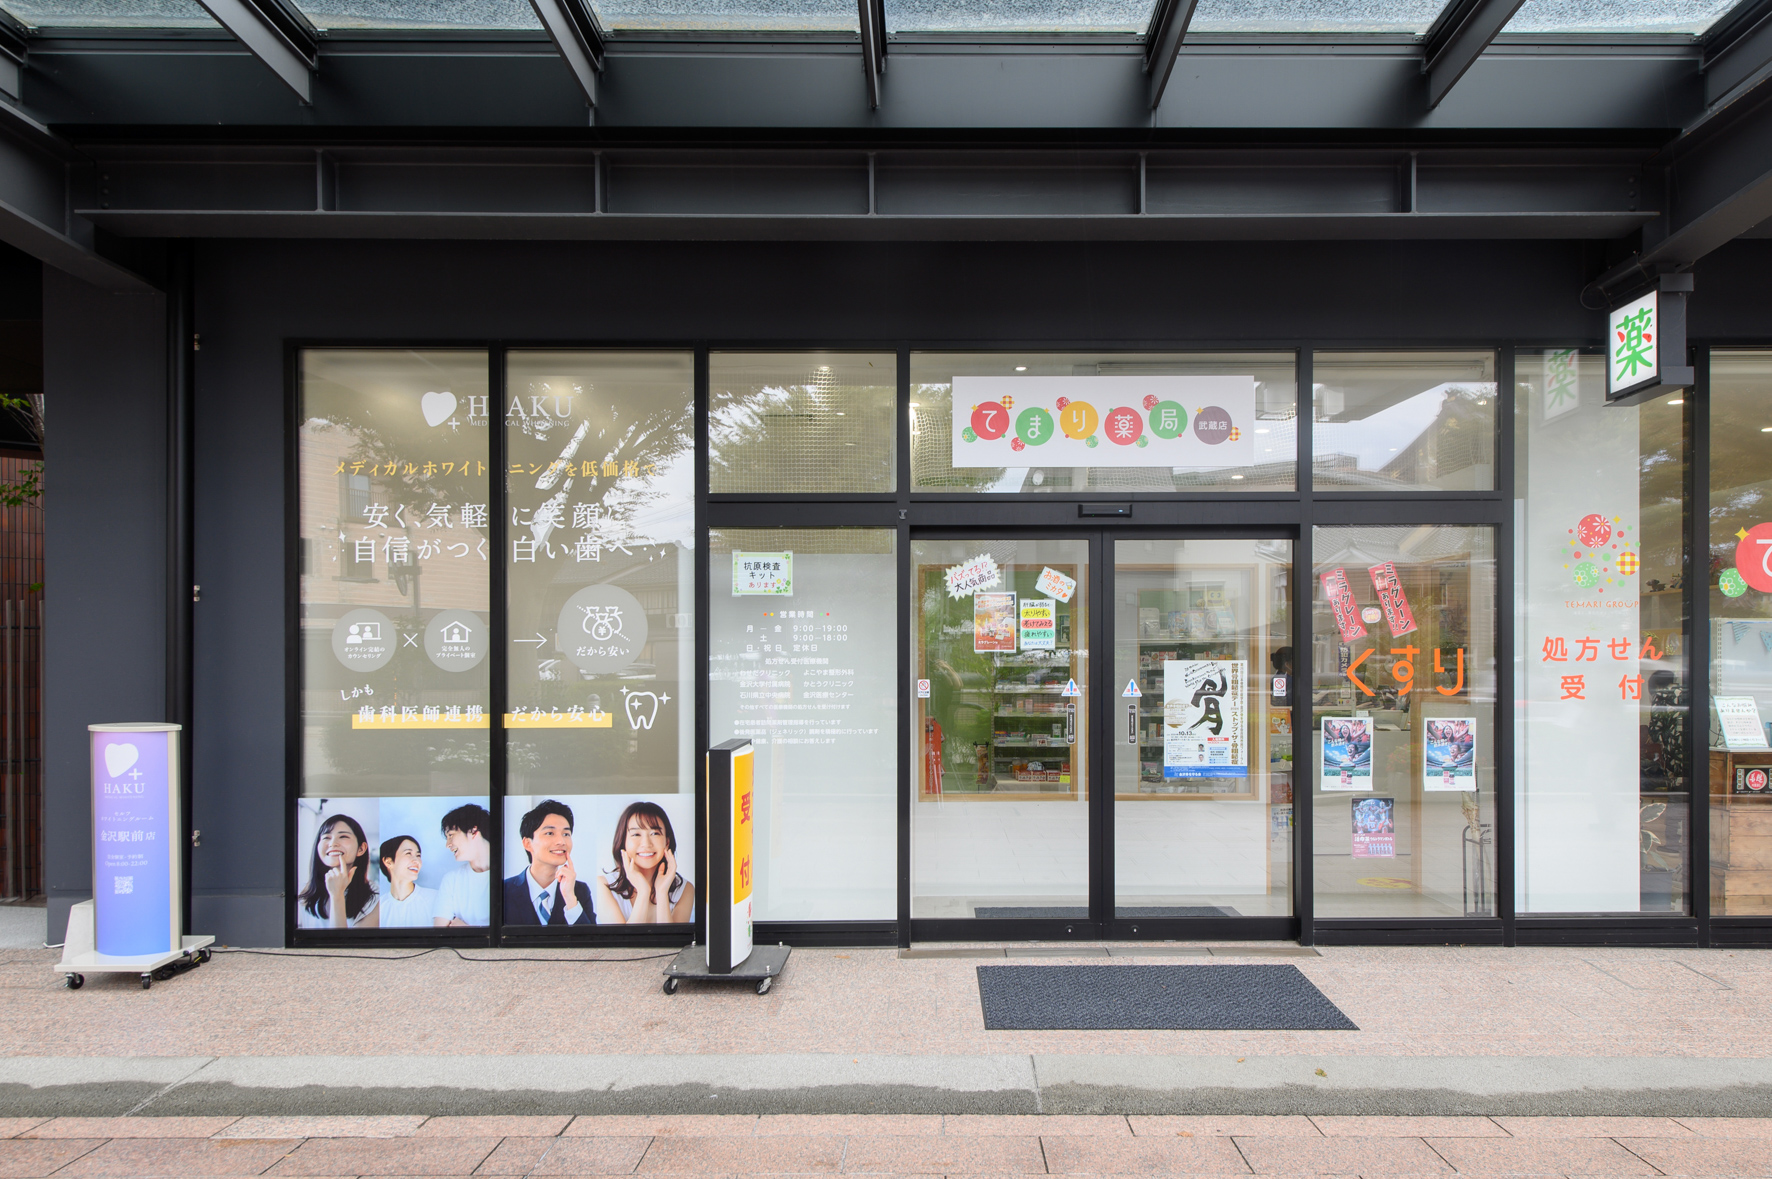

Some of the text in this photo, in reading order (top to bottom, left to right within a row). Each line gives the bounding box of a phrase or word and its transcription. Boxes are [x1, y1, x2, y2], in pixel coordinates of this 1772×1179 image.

[1615, 307, 1653, 382] 薬
[982, 408, 1228, 439] てまり薬局 武蔵店
[332, 460, 656, 478] メディカルホワイトニングを低価格で
[354, 534, 633, 563] 自信がつく白い歯へ
[744, 562, 781, 571] 抗原検査
[749, 572, 775, 580] キット
[954, 570, 996, 593] 大人気商品
[1335, 570, 1361, 637] ミラグレーン
[1384, 564, 1411, 631] ミラグレーン
[1564, 600, 1602, 608] TEMARI
[779, 610, 814, 619] 営業時間
[759, 634, 768, 642] 土
[576, 646, 630, 657] だから安い
[792, 644, 818, 652] 定休日
[1542, 636, 1663, 662] 処方せん
[1346, 644, 1464, 697] くすり
[340, 684, 375, 702] しかも
[1560, 674, 1645, 700] 受付
[358, 704, 606, 724] 歯科医師連携 だから安心
[103, 783, 145, 794] HAKU
[100, 830, 156, 842] 金沢駅前店
